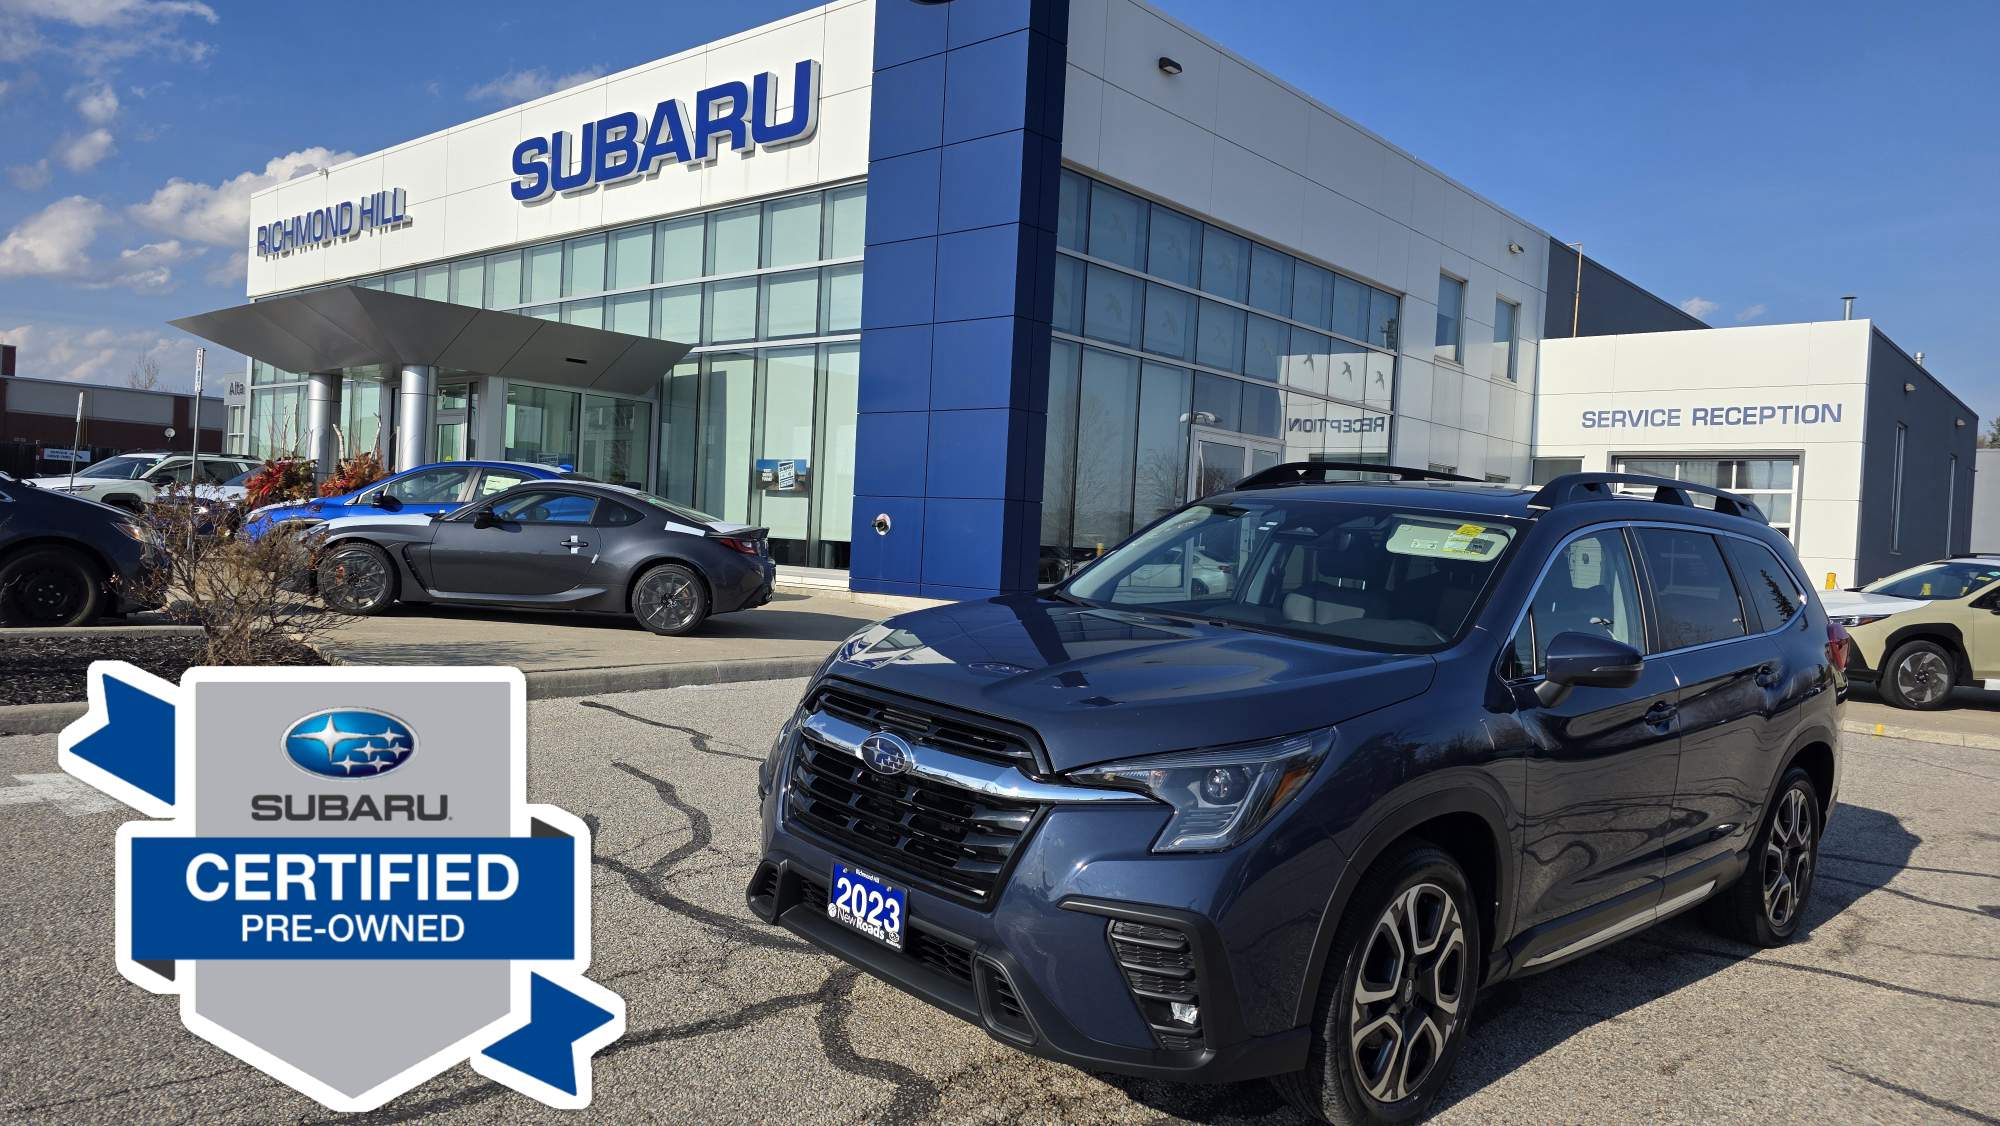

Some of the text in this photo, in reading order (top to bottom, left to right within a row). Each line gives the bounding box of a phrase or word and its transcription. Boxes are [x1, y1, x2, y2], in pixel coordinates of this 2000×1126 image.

[511, 60, 818, 201] SUBARU
[257, 187, 408, 257] RICHMOND HILL
[1581, 403, 1842, 428] SERVICE RECEPTION
[836, 877, 900, 932] 2023
